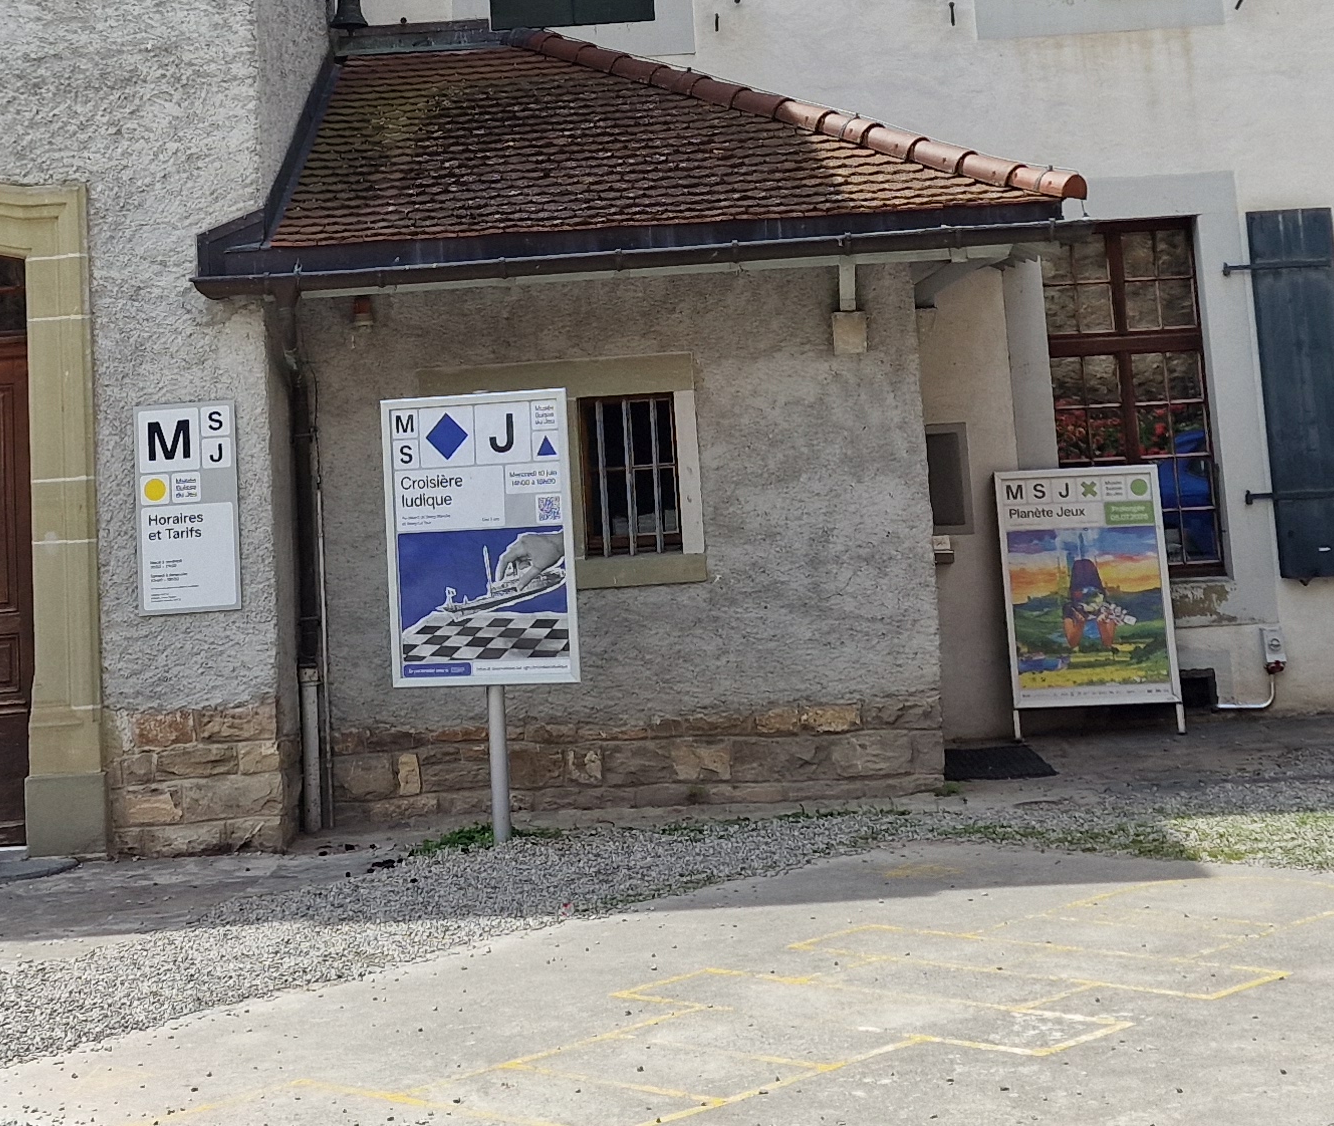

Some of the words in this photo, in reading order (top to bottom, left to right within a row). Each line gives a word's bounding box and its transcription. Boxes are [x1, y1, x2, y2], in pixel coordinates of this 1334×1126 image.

[207, 411, 223, 431] S
[395, 414, 415, 434] M
[147, 419, 191, 461] M
[489, 413, 515, 453] J
[209, 443, 223, 463] J
[399, 445, 414, 465] S
[400, 474, 463, 491] Croisière
[1005, 484, 1024, 501] M
[1033, 483, 1046, 499] S
[1058, 482, 1070, 499] J
[401, 493, 453, 510] ludique
[148, 513, 204, 526] Horaires
[1008, 507, 1054, 519] Planète
[1056, 506, 1085, 517] Jeux
[148, 529, 162, 541] et
[165, 526, 202, 540] Tarifs
